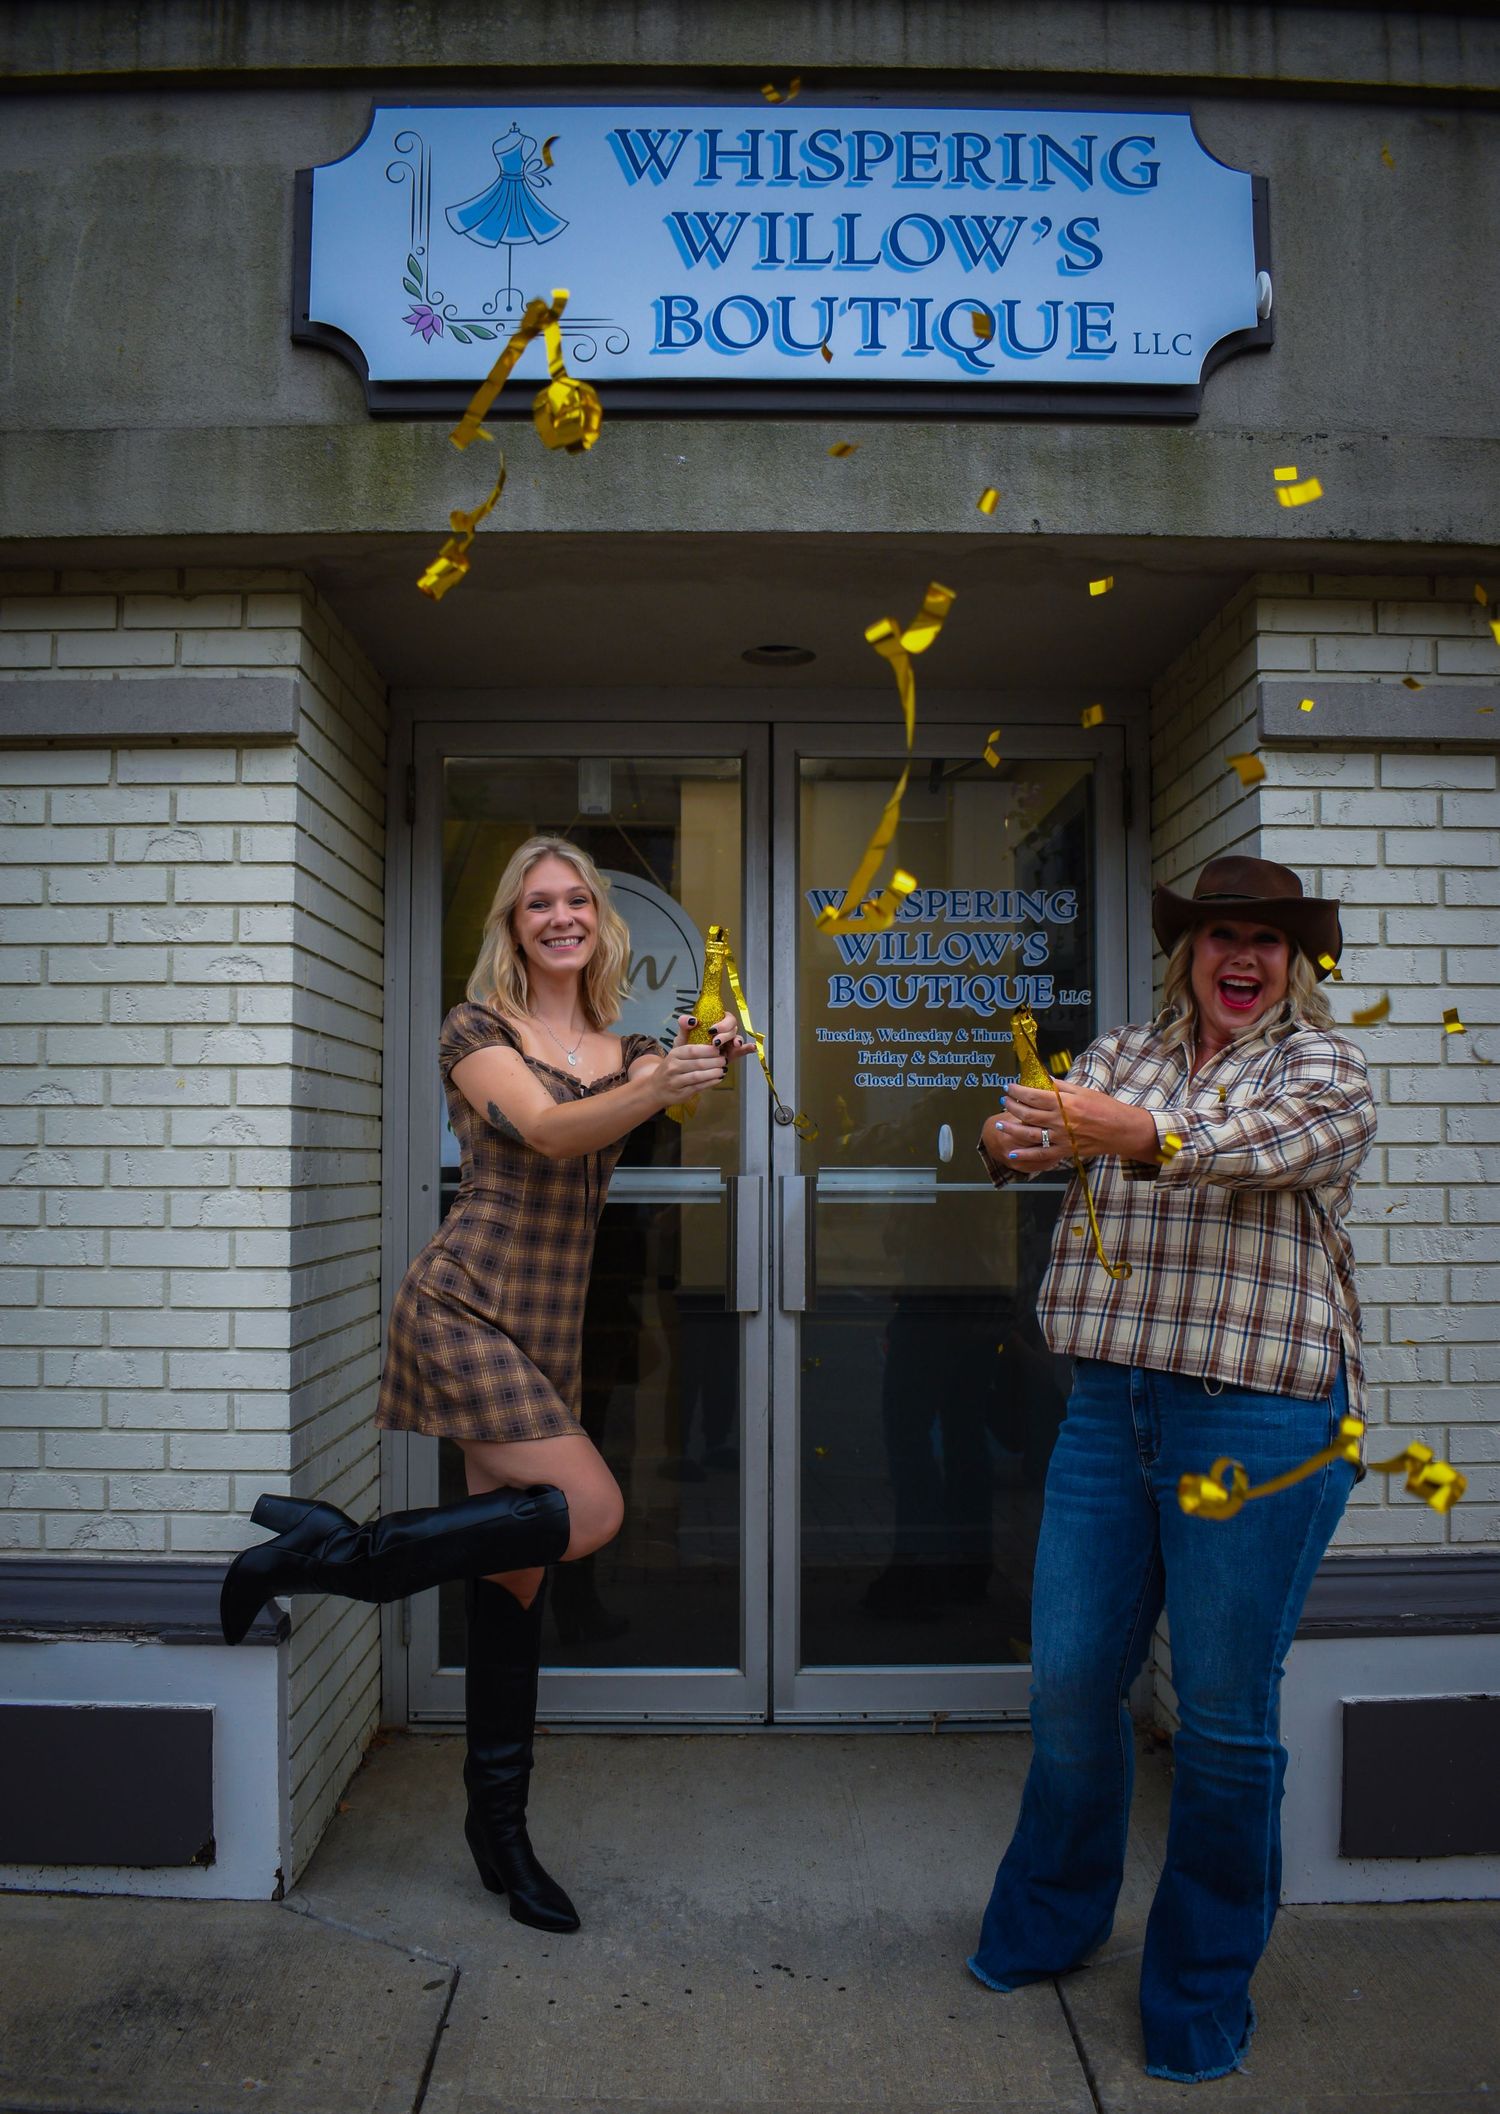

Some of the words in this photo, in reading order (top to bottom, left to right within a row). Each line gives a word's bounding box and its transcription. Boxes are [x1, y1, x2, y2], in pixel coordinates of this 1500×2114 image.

[605, 128, 1161, 195] WHISPERING
[662, 211, 1103, 277] WILLOW'S
[649, 295, 1118, 375] BOUTIQUE
[1133, 332, 1193, 356] LLC
[805, 888, 1078, 924] WSPERING
[833, 931, 1050, 966] WILLOW'S
[827, 974, 1055, 1017] BOUTIQUE
[1059, 990, 1091, 1005] LLC
[816, 1028, 875, 1045] Tuesday,
[878, 1028, 951, 1045] Wednesday
[956, 1029, 969, 1042] &
[971, 1028, 1013, 1042] Thurs
[858, 1051, 907, 1068] Friday
[911, 1052, 925, 1065] &
[928, 1051, 995, 1068] Saturday
[854, 1073, 903, 1087] Closed
[906, 1073, 961, 1090] Sunday
[964, 1074, 979, 1087] &
